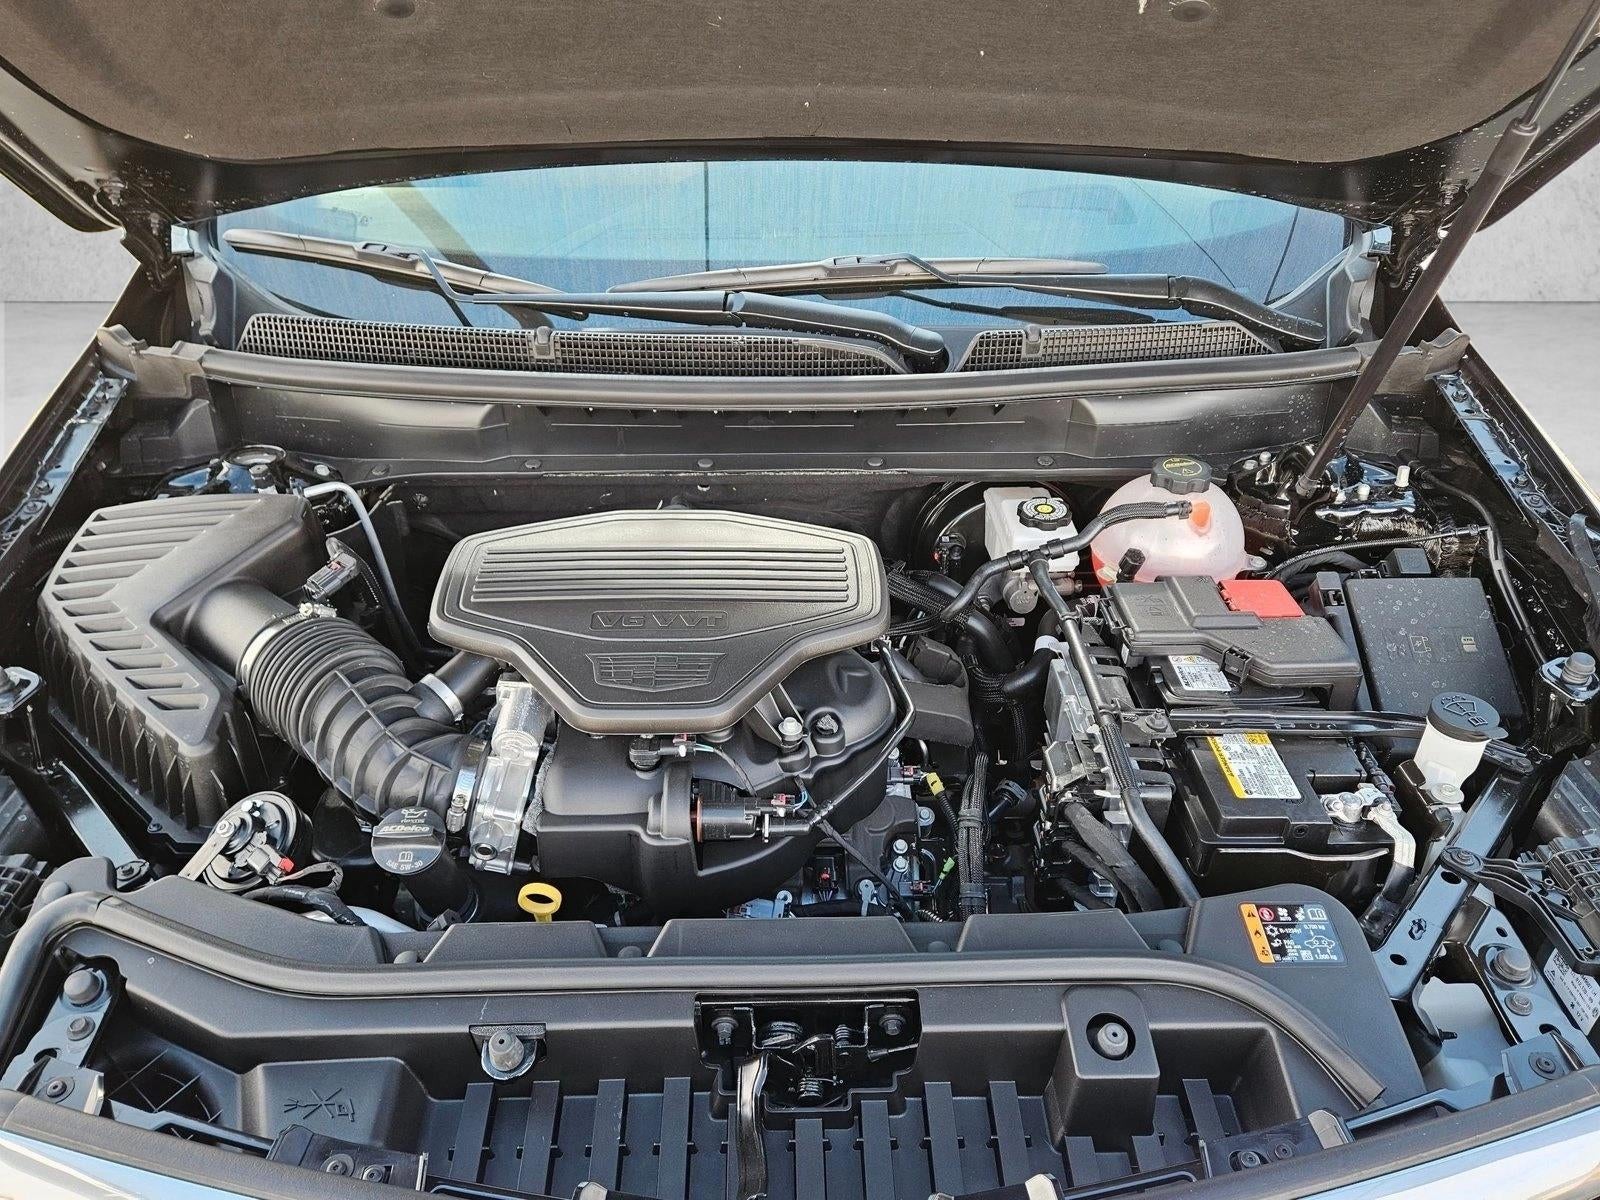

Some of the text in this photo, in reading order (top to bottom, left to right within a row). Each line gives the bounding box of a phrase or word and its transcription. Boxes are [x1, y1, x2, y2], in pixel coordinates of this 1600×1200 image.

[596, 614, 725, 627] V6 VVT
[386, 860, 423, 870] SAE 5W-30
